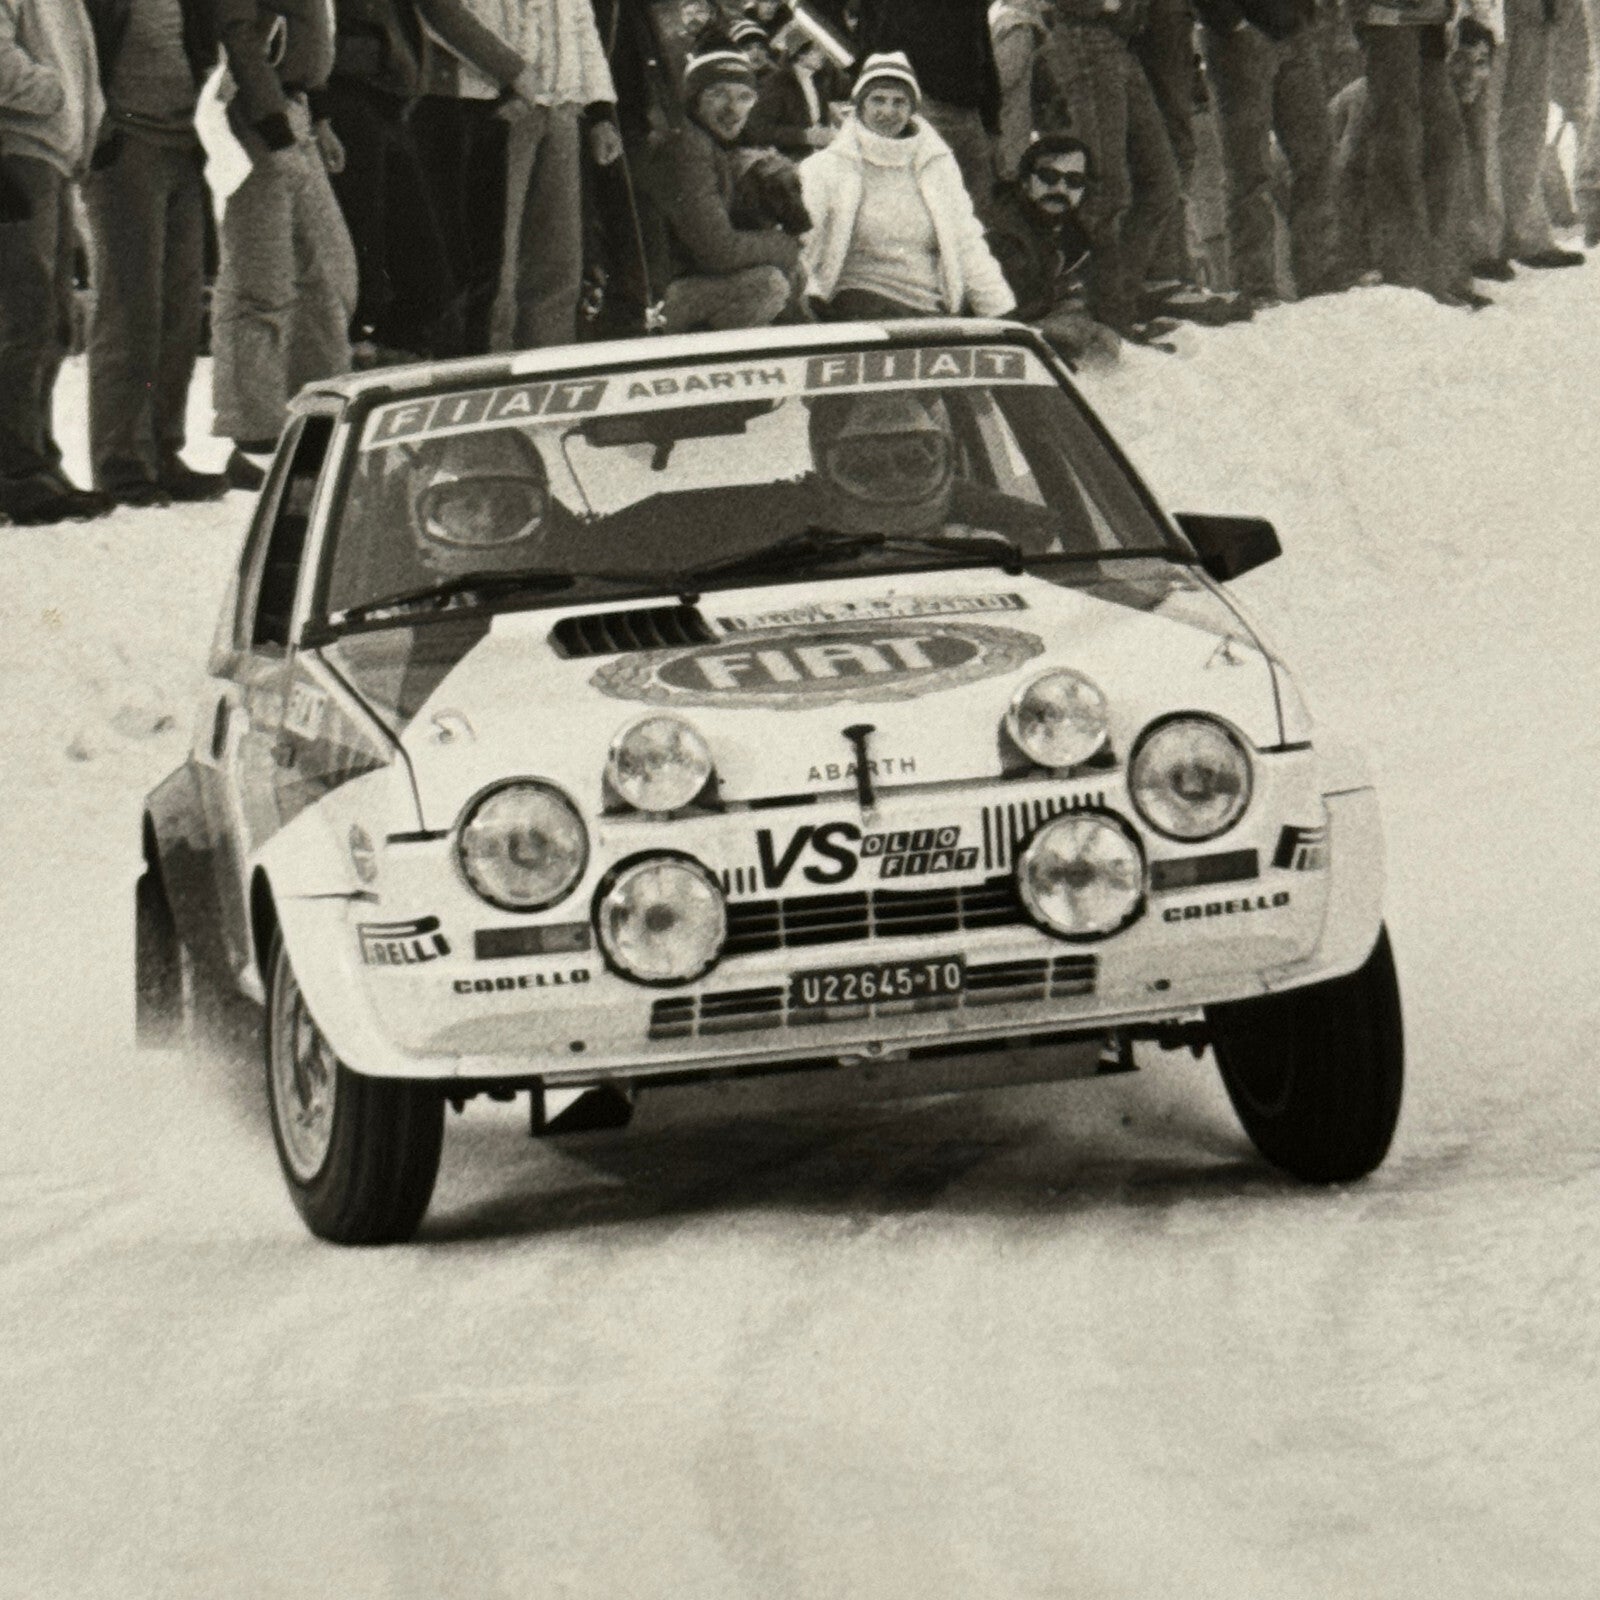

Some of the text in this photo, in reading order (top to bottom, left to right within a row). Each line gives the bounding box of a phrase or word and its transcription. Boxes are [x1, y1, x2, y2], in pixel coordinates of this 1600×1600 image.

[386, 353, 1017, 435] FIAT ABARTH FIAT
[697, 637, 934, 690] FIAT
[756, 821, 862, 889] VS
[863, 829, 958, 855] OLIO
[883, 850, 976, 875] FIAT
[357, 915, 451, 965] PRELLI
